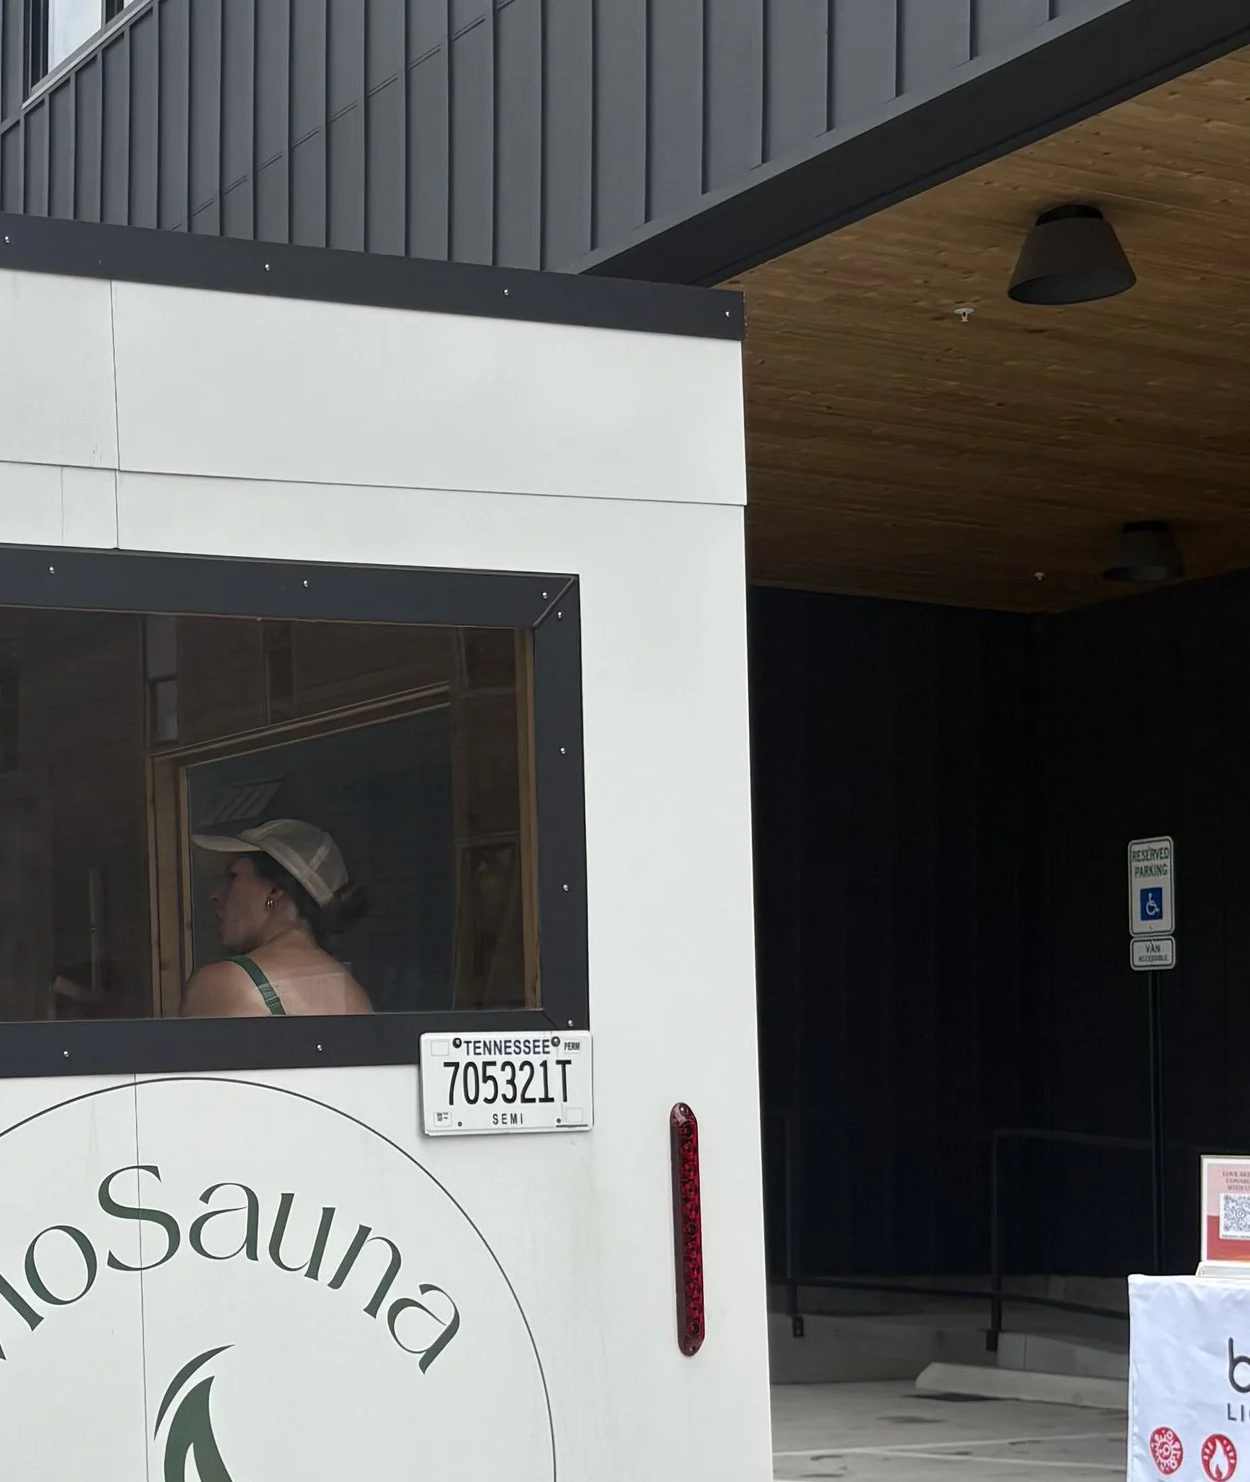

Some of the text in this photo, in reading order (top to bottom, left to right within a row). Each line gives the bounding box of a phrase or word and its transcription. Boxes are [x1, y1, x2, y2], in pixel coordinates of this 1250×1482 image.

[1131, 847, 1169, 862] RESERVED
[1134, 864, 1168, 878] PARKING
[1145, 944, 1161, 953] VAN
[464, 1039, 581, 1056] TENNESSEE PERM
[443, 1059, 572, 1105] 705321T
[492, 1113, 524, 1125] SEMI
[1227, 1402, 1250, 1422] LI
